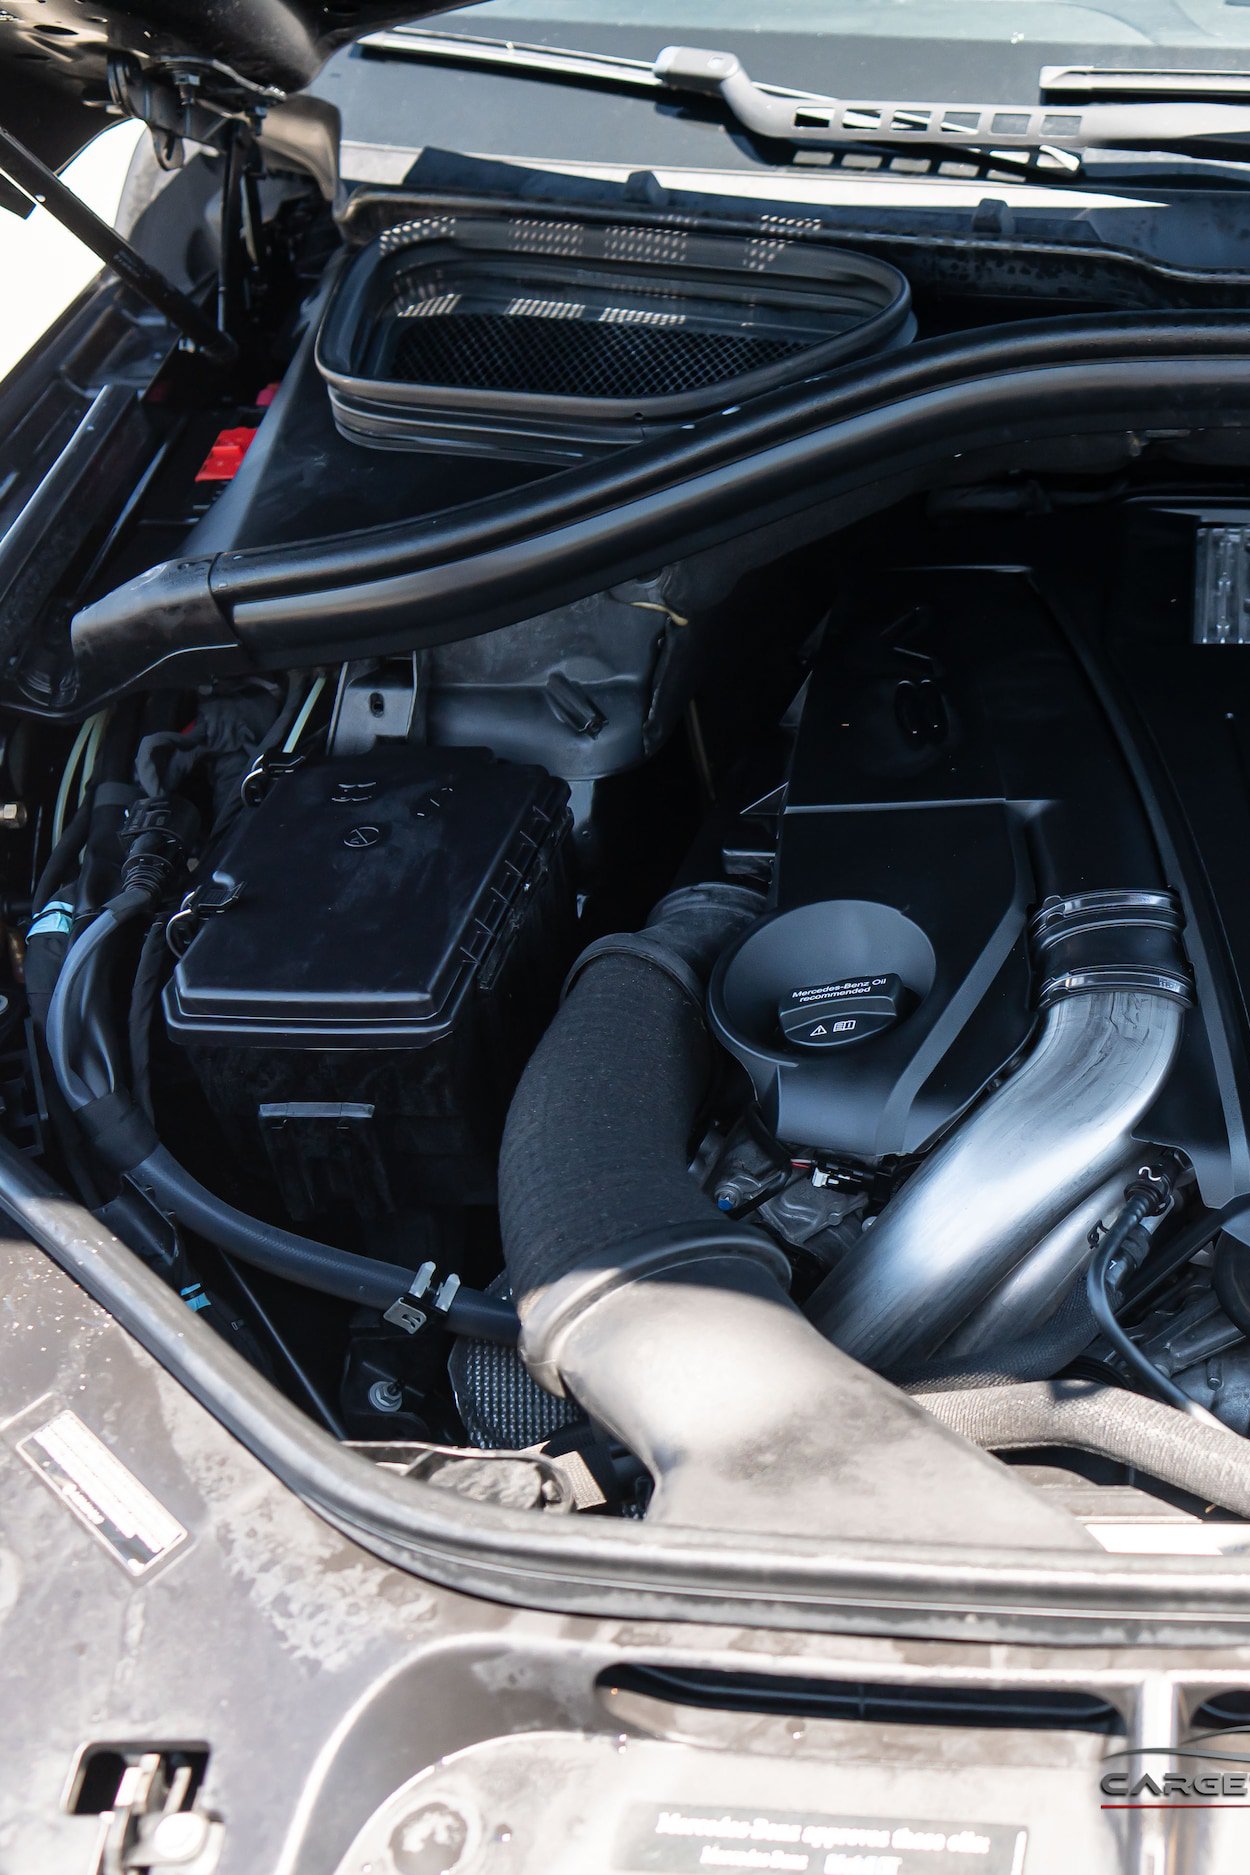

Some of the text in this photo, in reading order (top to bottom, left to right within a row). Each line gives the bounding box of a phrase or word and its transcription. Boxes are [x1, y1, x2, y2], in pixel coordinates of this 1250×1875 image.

[792, 978, 887, 998] Mercedes-Benz Oil
[800, 986, 871, 1003] recommended
